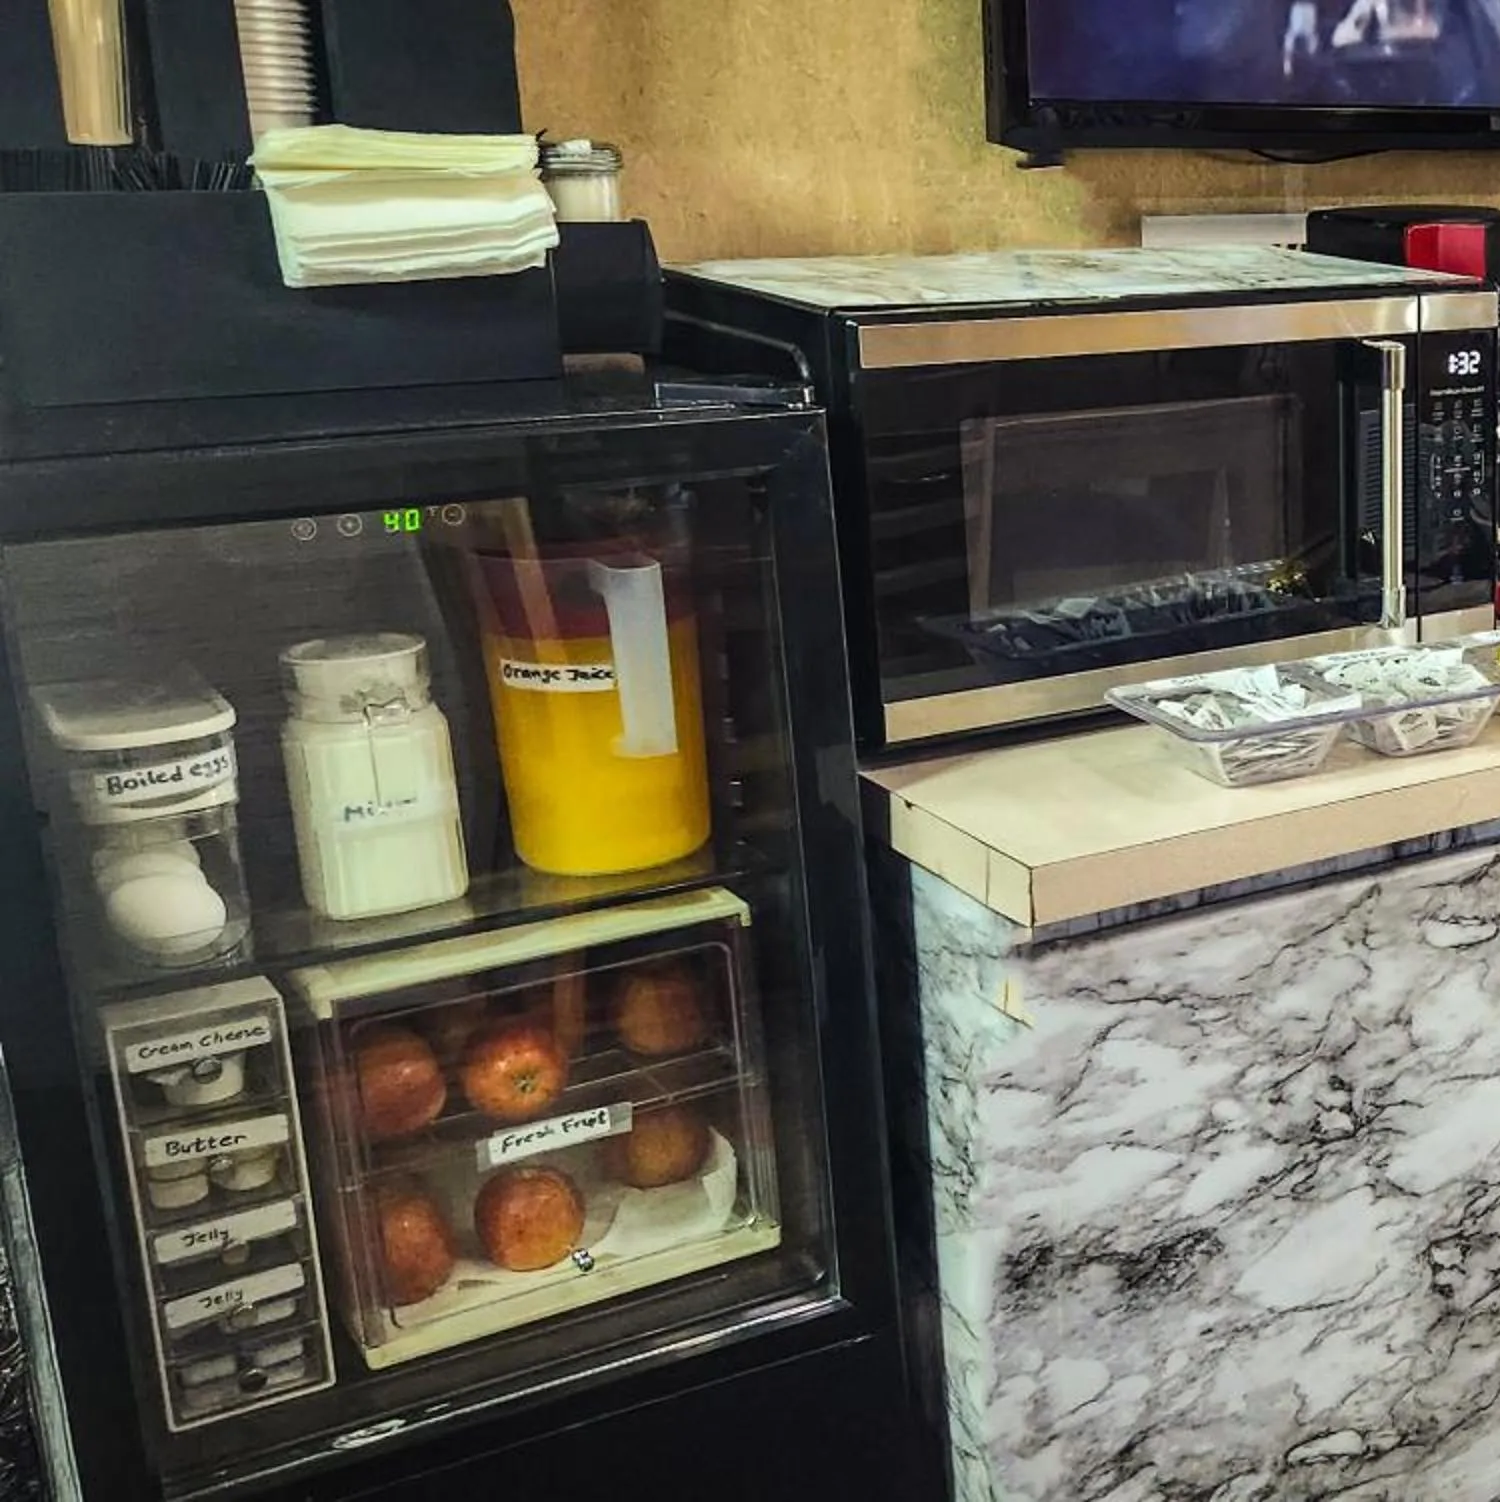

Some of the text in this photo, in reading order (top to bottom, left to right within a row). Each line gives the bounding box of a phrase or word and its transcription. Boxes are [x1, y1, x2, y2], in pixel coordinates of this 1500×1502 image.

[382, 509, 420, 533] 40
[503, 663, 561, 684] Orange
[106, 765, 184, 796] Boiled
[343, 797, 417, 822] Mi
[138, 1025, 267, 1059] Cream Cheese
[502, 1109, 607, 1153] Fresh Fruit
[164, 1134, 247, 1157] Butter
